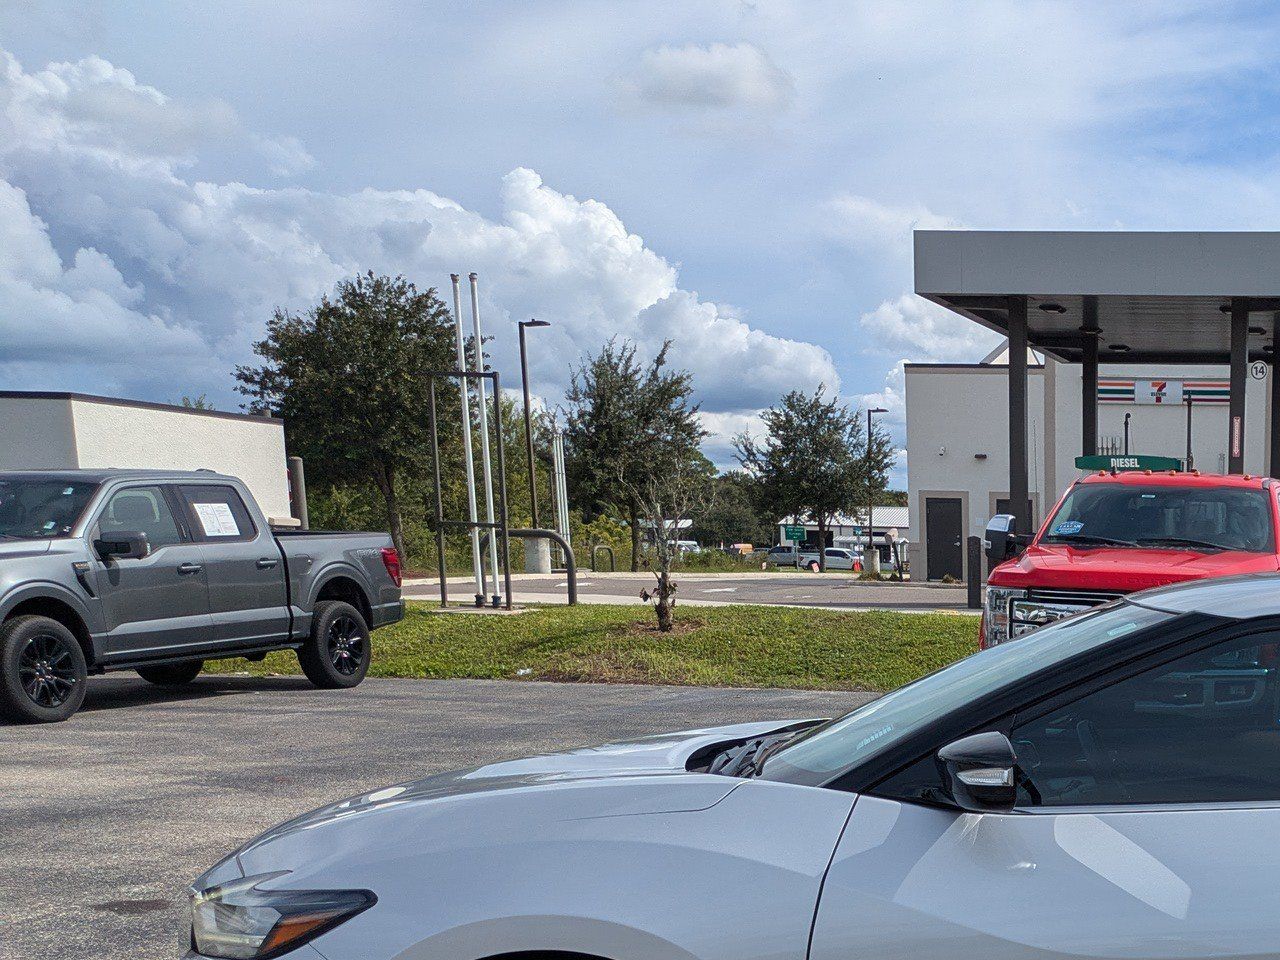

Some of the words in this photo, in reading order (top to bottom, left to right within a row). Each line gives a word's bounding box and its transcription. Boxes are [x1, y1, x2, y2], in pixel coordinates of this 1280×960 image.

[1254, 366, 1264, 375] 14
[1151, 382, 1166, 403] 7
[1111, 458, 1140, 468] DIESEL
